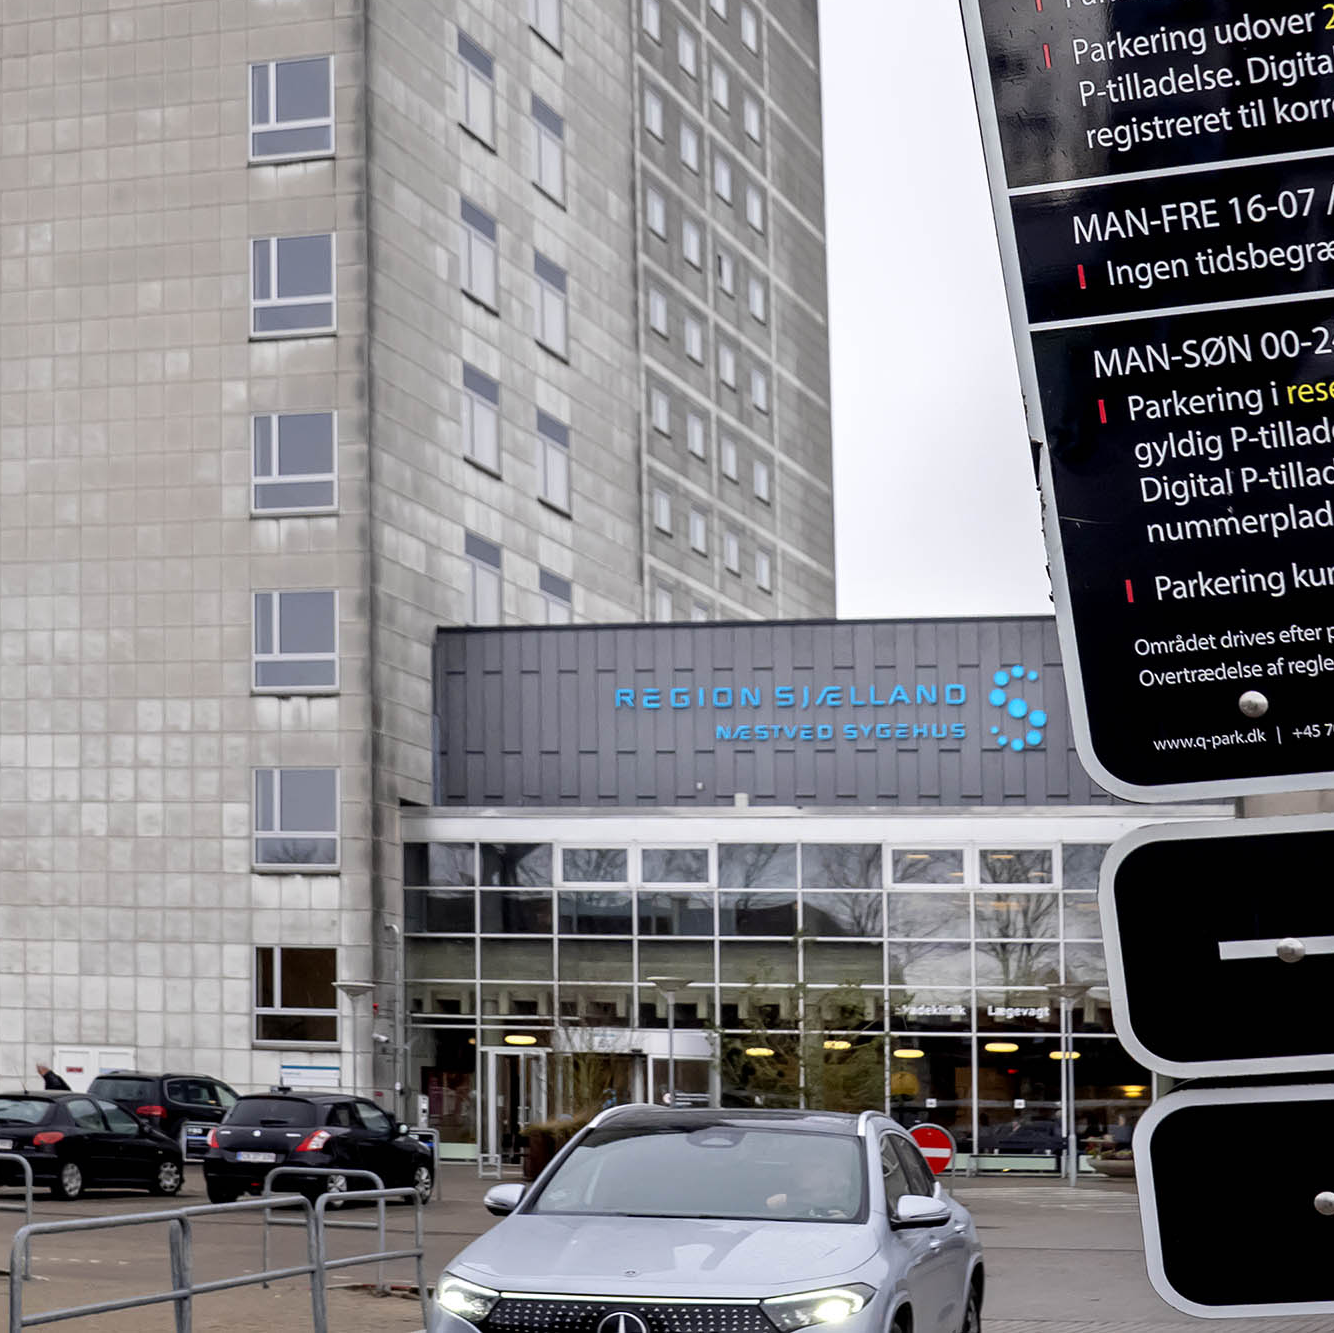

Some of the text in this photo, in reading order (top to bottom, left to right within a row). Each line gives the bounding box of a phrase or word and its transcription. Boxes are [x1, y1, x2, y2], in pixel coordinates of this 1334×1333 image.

[1073, 25, 1207, 65] Parkering
[1214, 11, 1316, 45] udover
[1079, 63, 1241, 107] P-tilladelse.
[1086, 107, 1233, 152] registreret
[1237, 99, 1267, 129] til
[1073, 198, 1221, 245] MAN-FRE
[1228, 187, 1316, 225] 16-07
[1106, 258, 1189, 290] Ingen
[1094, 334, 1253, 379] MAN-SØN
[1127, 386, 1264, 421] Parkering
[1270, 380, 1279, 407] i
[1134, 430, 1224, 469] gyldig
[1140, 468, 1234, 507] Digital
[1154, 568, 1286, 601] Parkering
[1134, 633, 1218, 656] Området
[1220, 630, 1276, 649] drives
[1279, 624, 1323, 644] efter
[1139, 661, 1263, 687] Overtrædelse
[1267, 657, 1285, 676] af
[614, 683, 967, 710] REGION SJÆLLAND
[716, 723, 967, 741] NÆSTVED SYGEHUS
[1153, 728, 1267, 751] www.q-park.dk
[1292, 724, 1321, 739] +45
